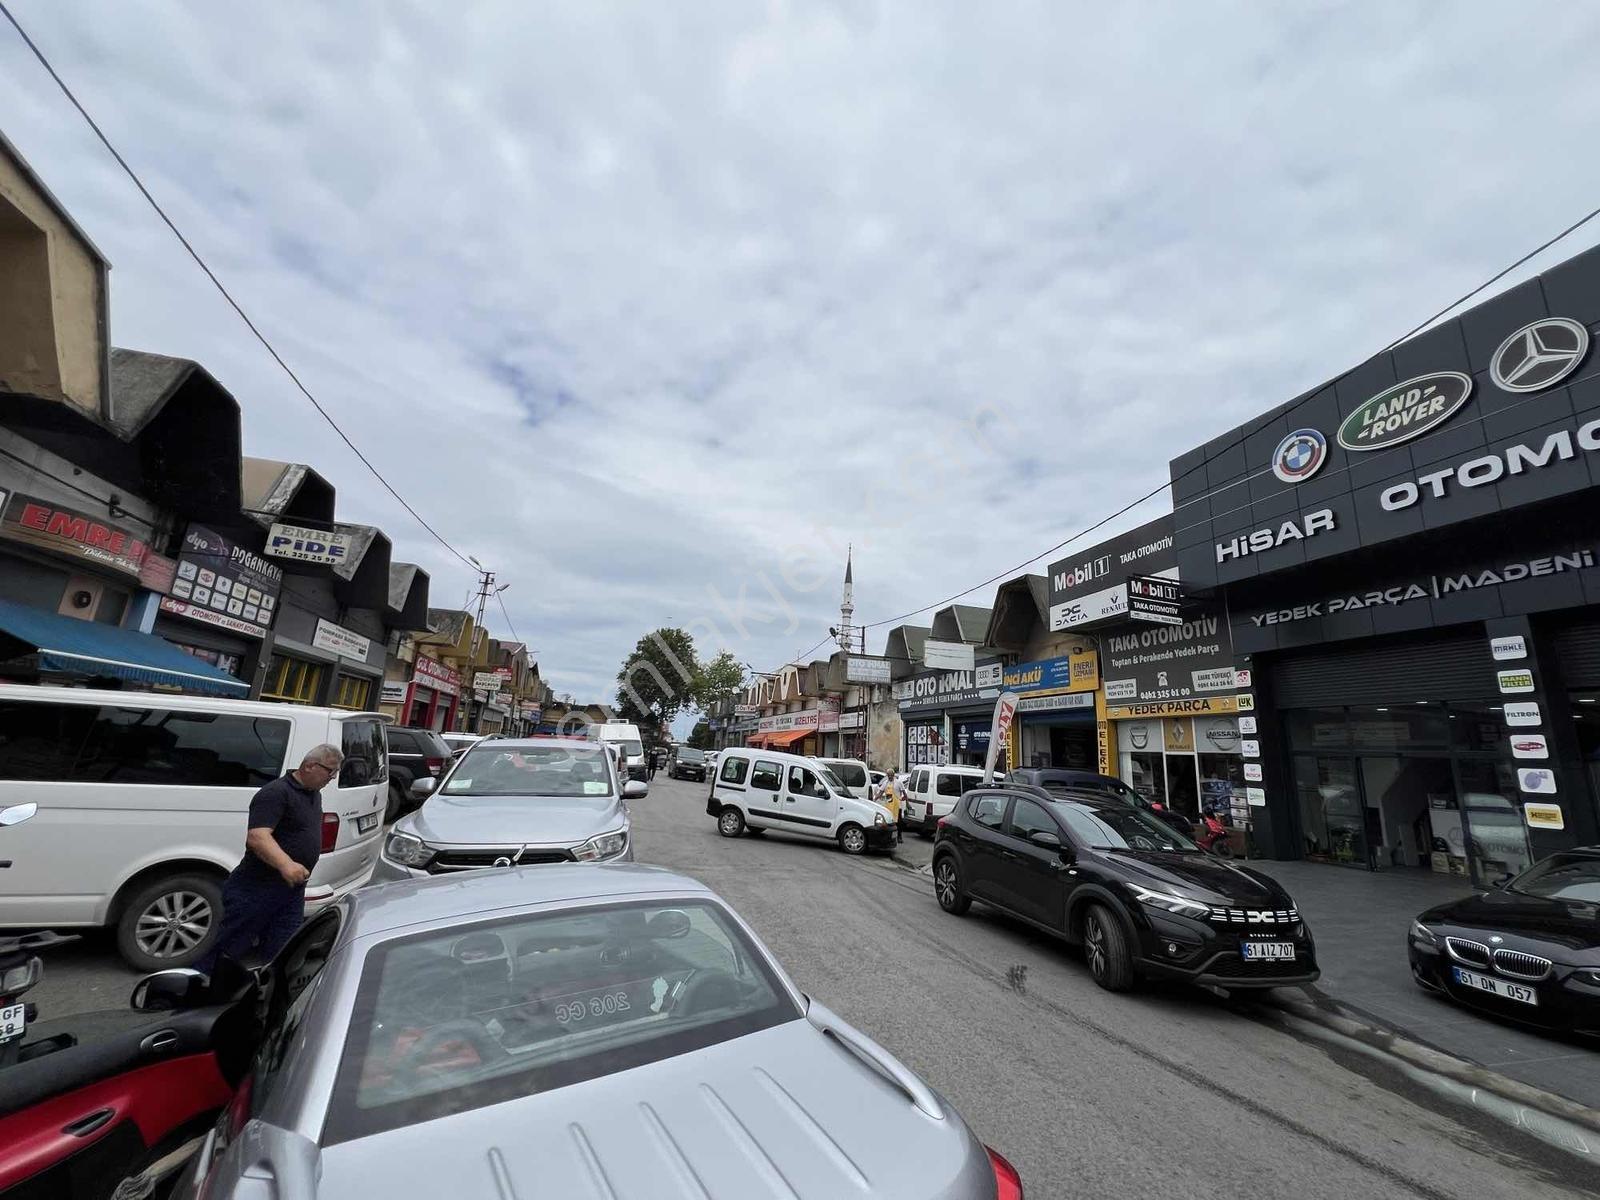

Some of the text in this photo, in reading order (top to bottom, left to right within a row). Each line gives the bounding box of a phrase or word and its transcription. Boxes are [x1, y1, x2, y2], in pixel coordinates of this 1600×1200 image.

[1362, 388, 1421, 426] LAND
[1370, 395, 1447, 439] ROVER
[20, 503, 126, 554] EMRE
[281, 526, 344, 545] EMRE
[187, 532, 208, 550] dyo
[274, 549, 288, 557] Tel.
[1054, 561, 1092, 592] Mobil
[1120, 553, 1137, 564] TAKA
[1137, 536, 1173, 557] OTOMOTİV
[1131, 581, 1163, 598] Mobil
[1133, 602, 1178, 615] TAKA OTOMOTİV
[1251, 604, 1322, 628] YEDEK
[1329, 584, 1428, 613] PARÇA
[1056, 613, 1088, 626] DACIA
[1108, 614, 1218, 653] TAKA OTOMOTİV
[1112, 643, 1220, 669] Toptan & Perakende Yedek Parça
[1020, 666, 1042, 684] AKÜ
[1501, 675, 1530, 683] MANN
[1503, 680, 1531, 688] FILTER
[916, 678, 936, 697] OTO
[1141, 690, 1156, 700] 0462
[1157, 689, 1170, 699] 325
[1171, 687, 1180, 697] 61
[1180, 687, 1190, 697] 00
[1128, 702, 1165, 716] YEDEK
[1208, 730, 1238, 738] NISSAN
[1247, 944, 1293, 957] 61 AIZ 707
[1461, 971, 1532, 1002] 61 DN 057
[3, 1005, 23, 1020] GF
